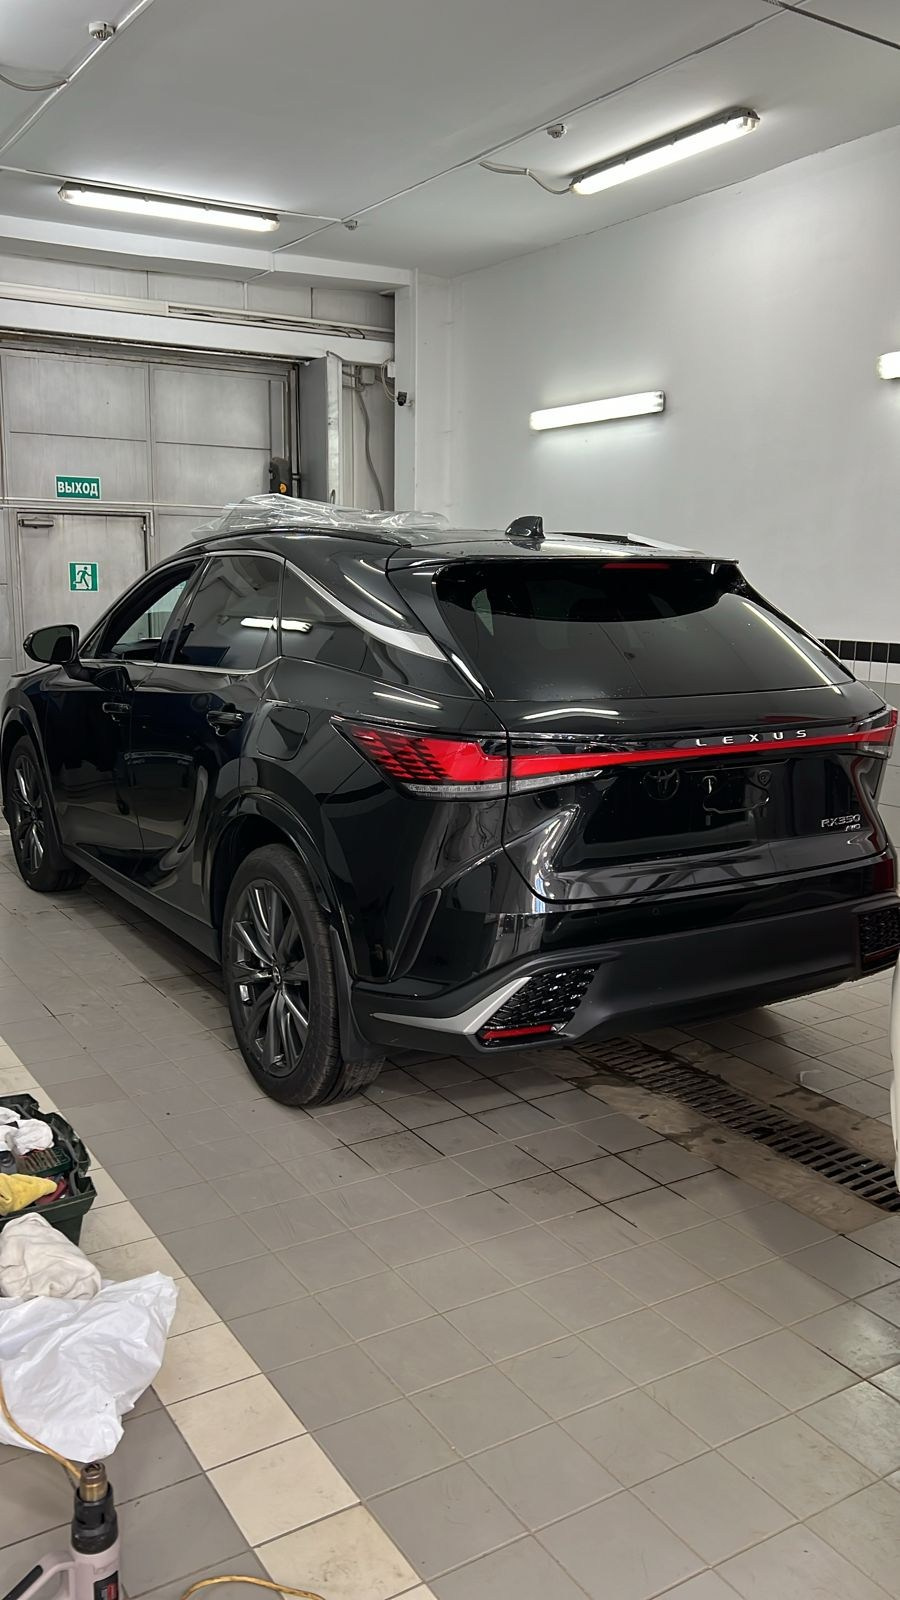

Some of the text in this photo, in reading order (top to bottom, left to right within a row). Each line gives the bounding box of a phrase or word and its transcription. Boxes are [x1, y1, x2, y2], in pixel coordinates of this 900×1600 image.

[57, 481, 98, 497] ВЫХОД
[695, 729, 807, 747] LEXUS
[821, 813, 861, 828] RX350
